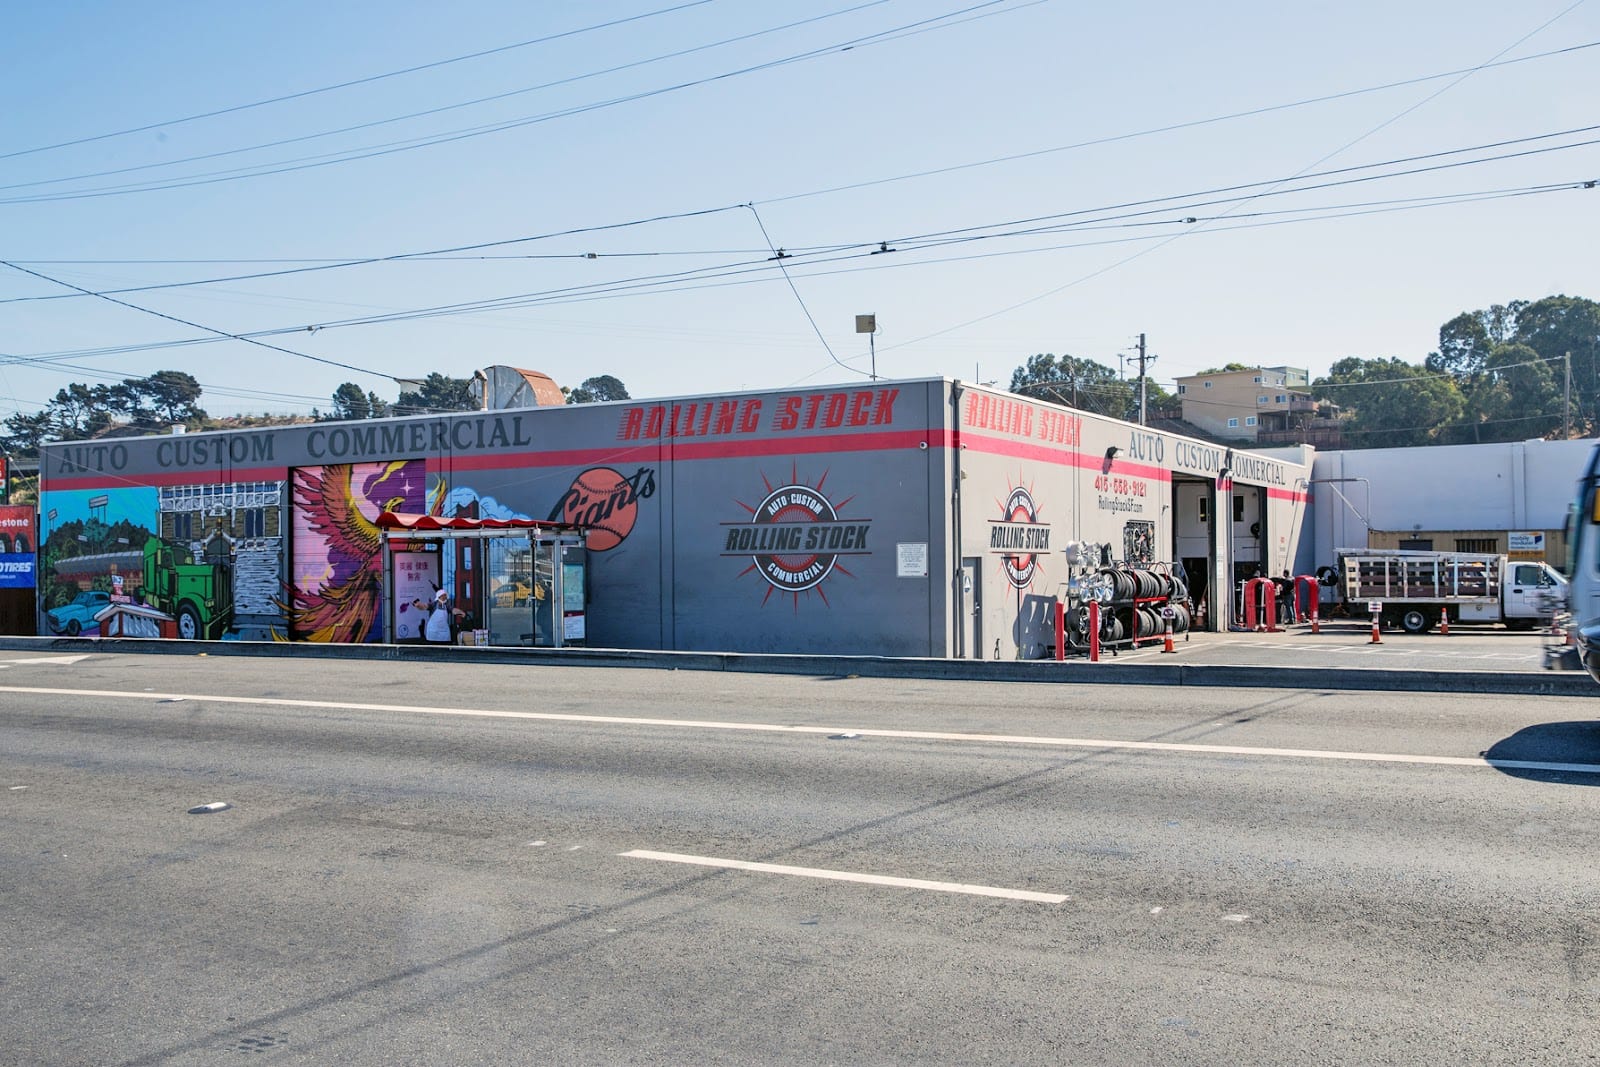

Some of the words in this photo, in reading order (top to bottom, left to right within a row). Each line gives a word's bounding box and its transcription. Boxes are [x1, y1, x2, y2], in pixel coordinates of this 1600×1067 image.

[616, 400, 762, 440] ROLLING
[771, 389, 899, 431] STOCK
[963, 392, 1034, 437] ROLLING
[1037, 409, 1083, 447] STOCK
[59, 444, 128, 473] AUTO
[156, 434, 275, 467] CUSTOM
[306, 416, 531, 458] COMMERCIAL
[1129, 431, 1164, 463] AUTO
[1176, 441, 1219, 472] CUSTOM
[1232, 455, 1286, 485] OMMERCIAL
[547, 467, 655, 528] Giants
[767, 495, 787, 516] AUTO
[790, 493, 824, 515] CUSTOM
[726, 527, 802, 551] ROLLING
[805, 525, 870, 550] STOCK
[990, 526, 1025, 549] ROLLING
[1026, 528, 1050, 550] STOCK
[4, 562, 32, 573] TIRES
[767, 561, 824, 584] COMMERCIAL
